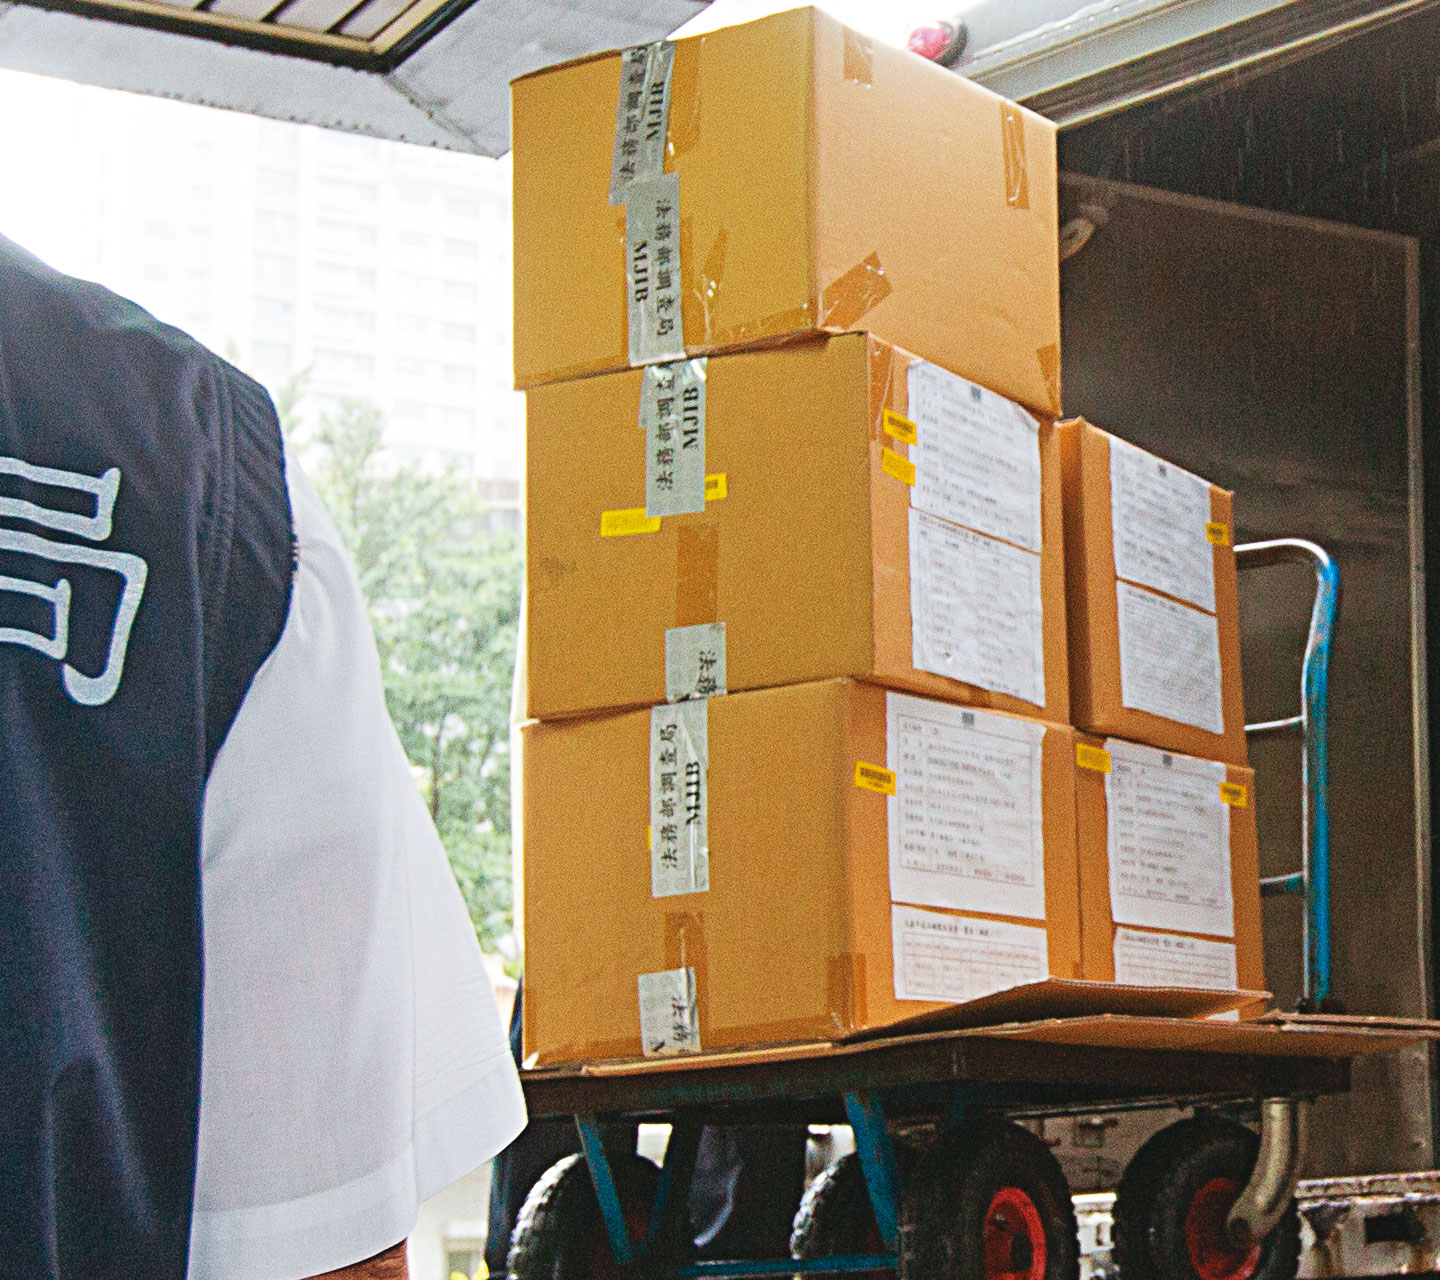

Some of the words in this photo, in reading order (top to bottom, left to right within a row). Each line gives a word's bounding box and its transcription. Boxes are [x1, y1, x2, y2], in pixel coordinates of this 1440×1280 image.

[646, 81, 664, 141] MJIB
[633, 240, 648, 302] MJIB
[655, 198, 675, 336] 法務部調查局
[682, 387, 699, 450] MJIB
[659, 723, 678, 869] 法務部調查局
[686, 761, 701, 825] MJIB
